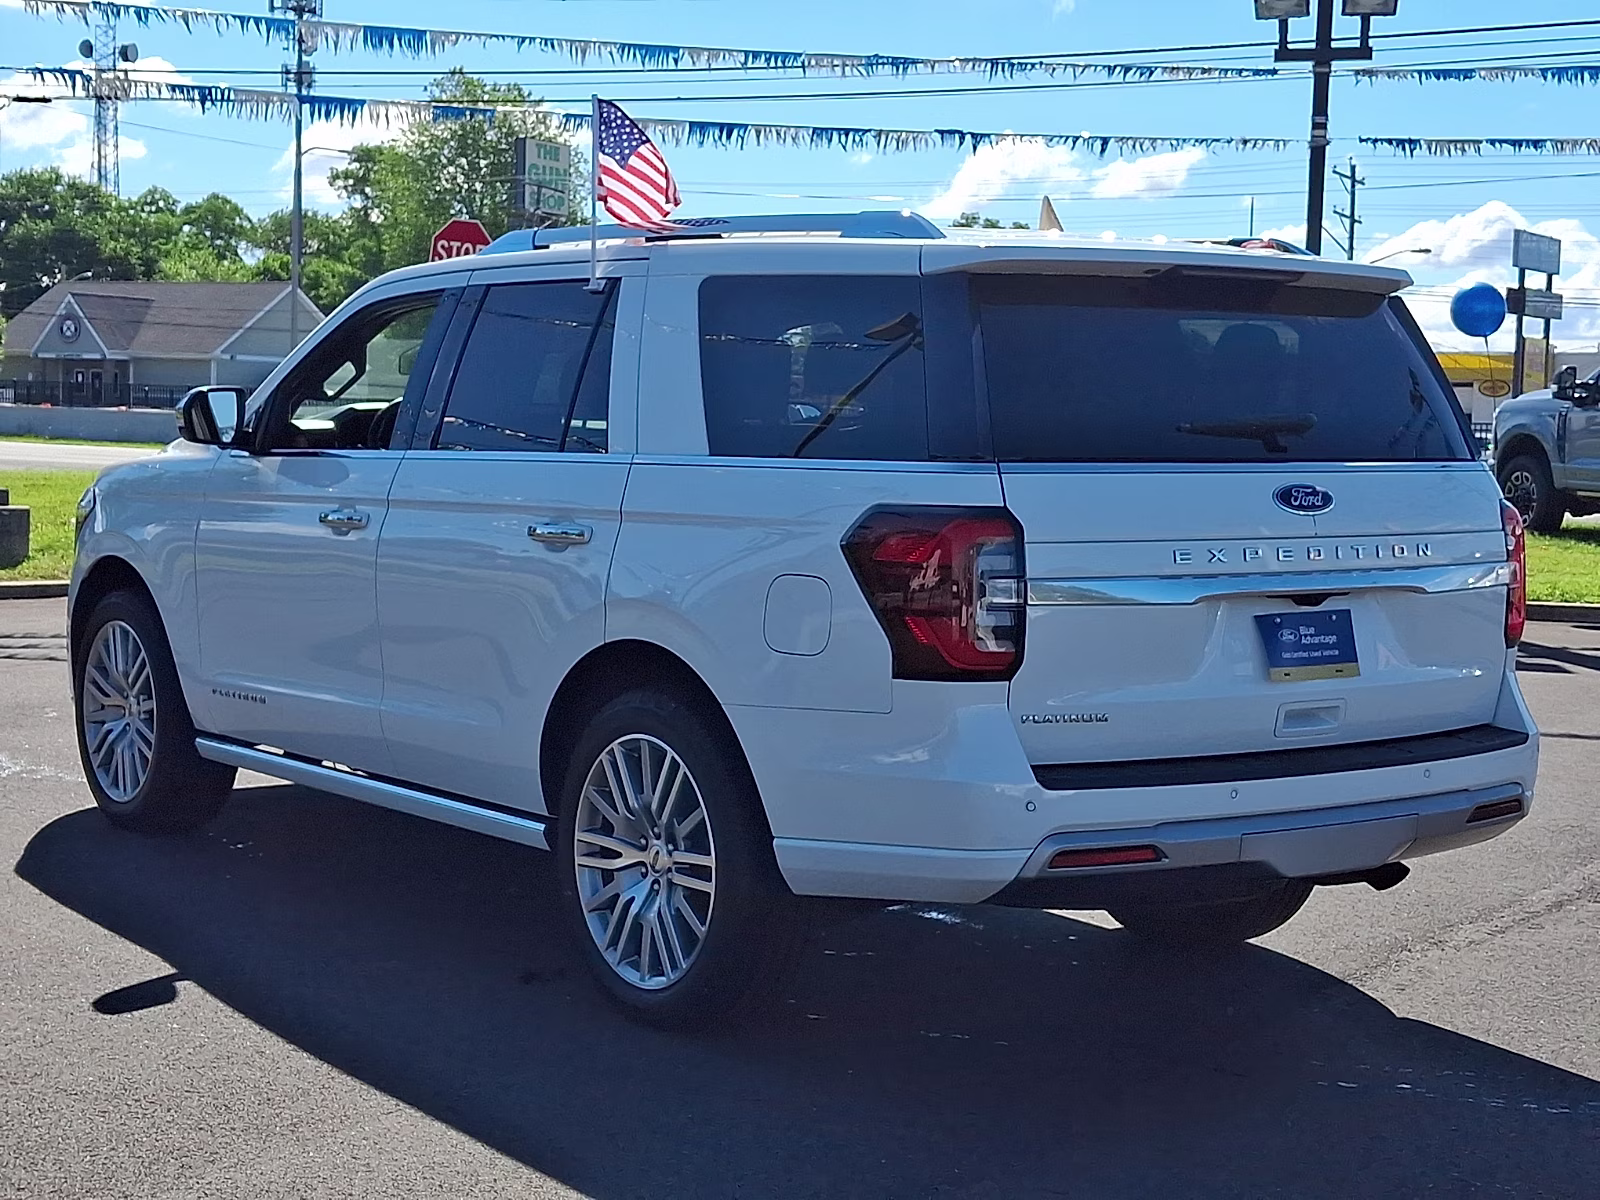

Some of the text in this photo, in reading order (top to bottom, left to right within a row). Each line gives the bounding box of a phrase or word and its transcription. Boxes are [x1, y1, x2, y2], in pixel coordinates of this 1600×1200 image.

[535, 143, 560, 162] THE
[527, 163, 568, 190] GUN
[1291, 487, 1324, 506] Ford
[1173, 543, 1433, 564] EXPEDITION
[1299, 625, 1315, 635] Blue
[1301, 635, 1337, 644] Advantage
[1021, 713, 1109, 724] PLATINUM
